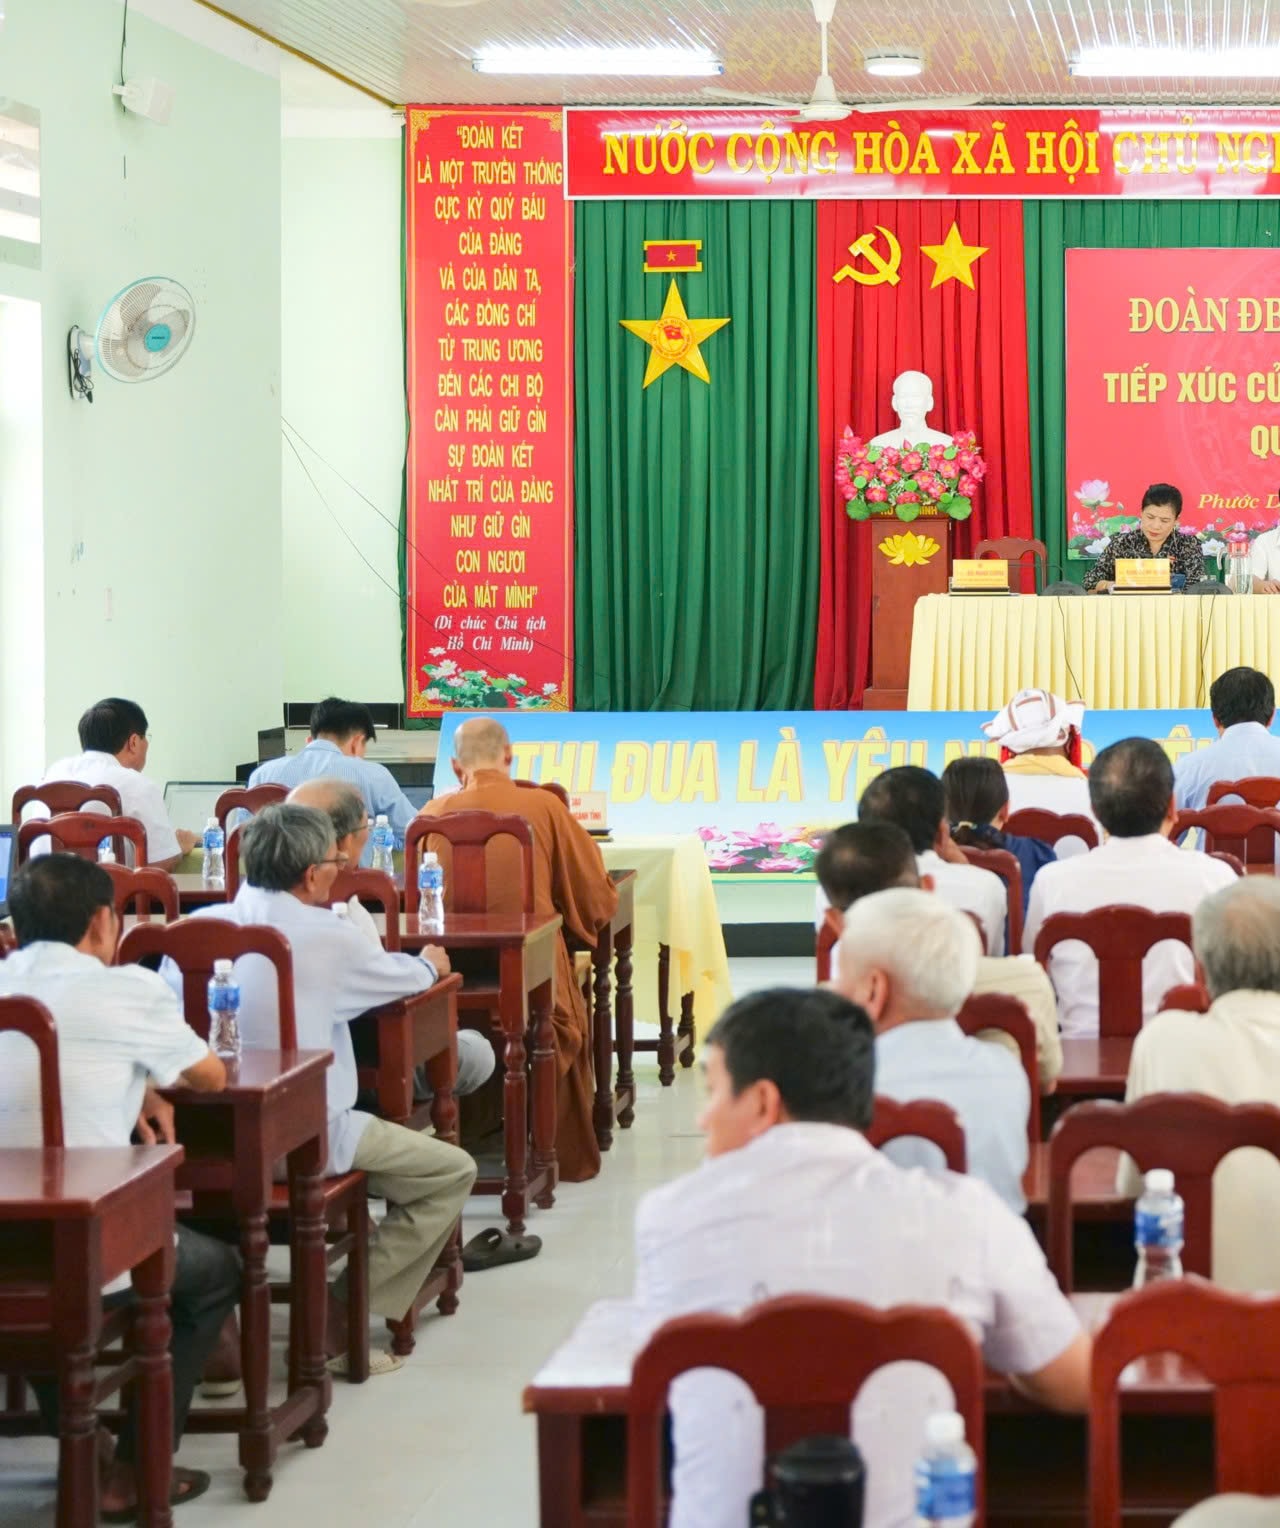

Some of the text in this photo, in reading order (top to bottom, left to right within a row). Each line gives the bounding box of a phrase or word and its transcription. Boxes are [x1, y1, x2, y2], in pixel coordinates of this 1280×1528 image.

[500, 121, 524, 149] KẾT
[603, 120, 716, 175] NƯỚC
[726, 121, 839, 184] CỘNG
[853, 120, 939, 175] HÒA
[952, 122, 1015, 174] XÃ
[1026, 118, 1100, 183] HỘI
[1112, 115, 1199, 175] CHỦ
[417, 155, 433, 184] LÀ
[522, 157, 564, 185] THỐNG
[467, 191, 484, 219] KỲ
[489, 191, 515, 222] QUÝ
[521, 191, 546, 221] BÁU
[458, 226, 523, 256] CỦA ĐẢNG
[439, 261, 542, 295] VÀ CỦA DÂN TA,
[445, 298, 536, 327] CÁC ĐỒNG CHÍ
[1129, 285, 1229, 332] ĐOÀN
[437, 332, 543, 362] TỪ TRUNG ƯƠNG
[437, 368, 544, 402] ĐẾN CÁC CHI BỘ
[1103, 363, 1168, 403] TIẾP
[1177, 366, 1237, 403] XÚC
[434, 404, 547, 433] CẦN PHẢI GIỮ GÌN
[447, 439, 534, 473] SỰ ĐOÀN KẾT
[428, 474, 554, 504] NHẤT TRÍ CỦA ĐẢNG
[1199, 493, 1260, 509] Phước
[450, 510, 531, 539] NHƯ GIỮ GÌN
[455, 549, 481, 573] CON
[443, 579, 468, 608] CỦA
[460, 616, 487, 630] chúc
[525, 616, 547, 633] tịch
[472, 636, 493, 650] Chí
[500, 636, 534, 652] Minh)
[511, 741, 599, 792] THI
[611, 740, 720, 804] ĐUA
[736, 726, 804, 804] LÀ
